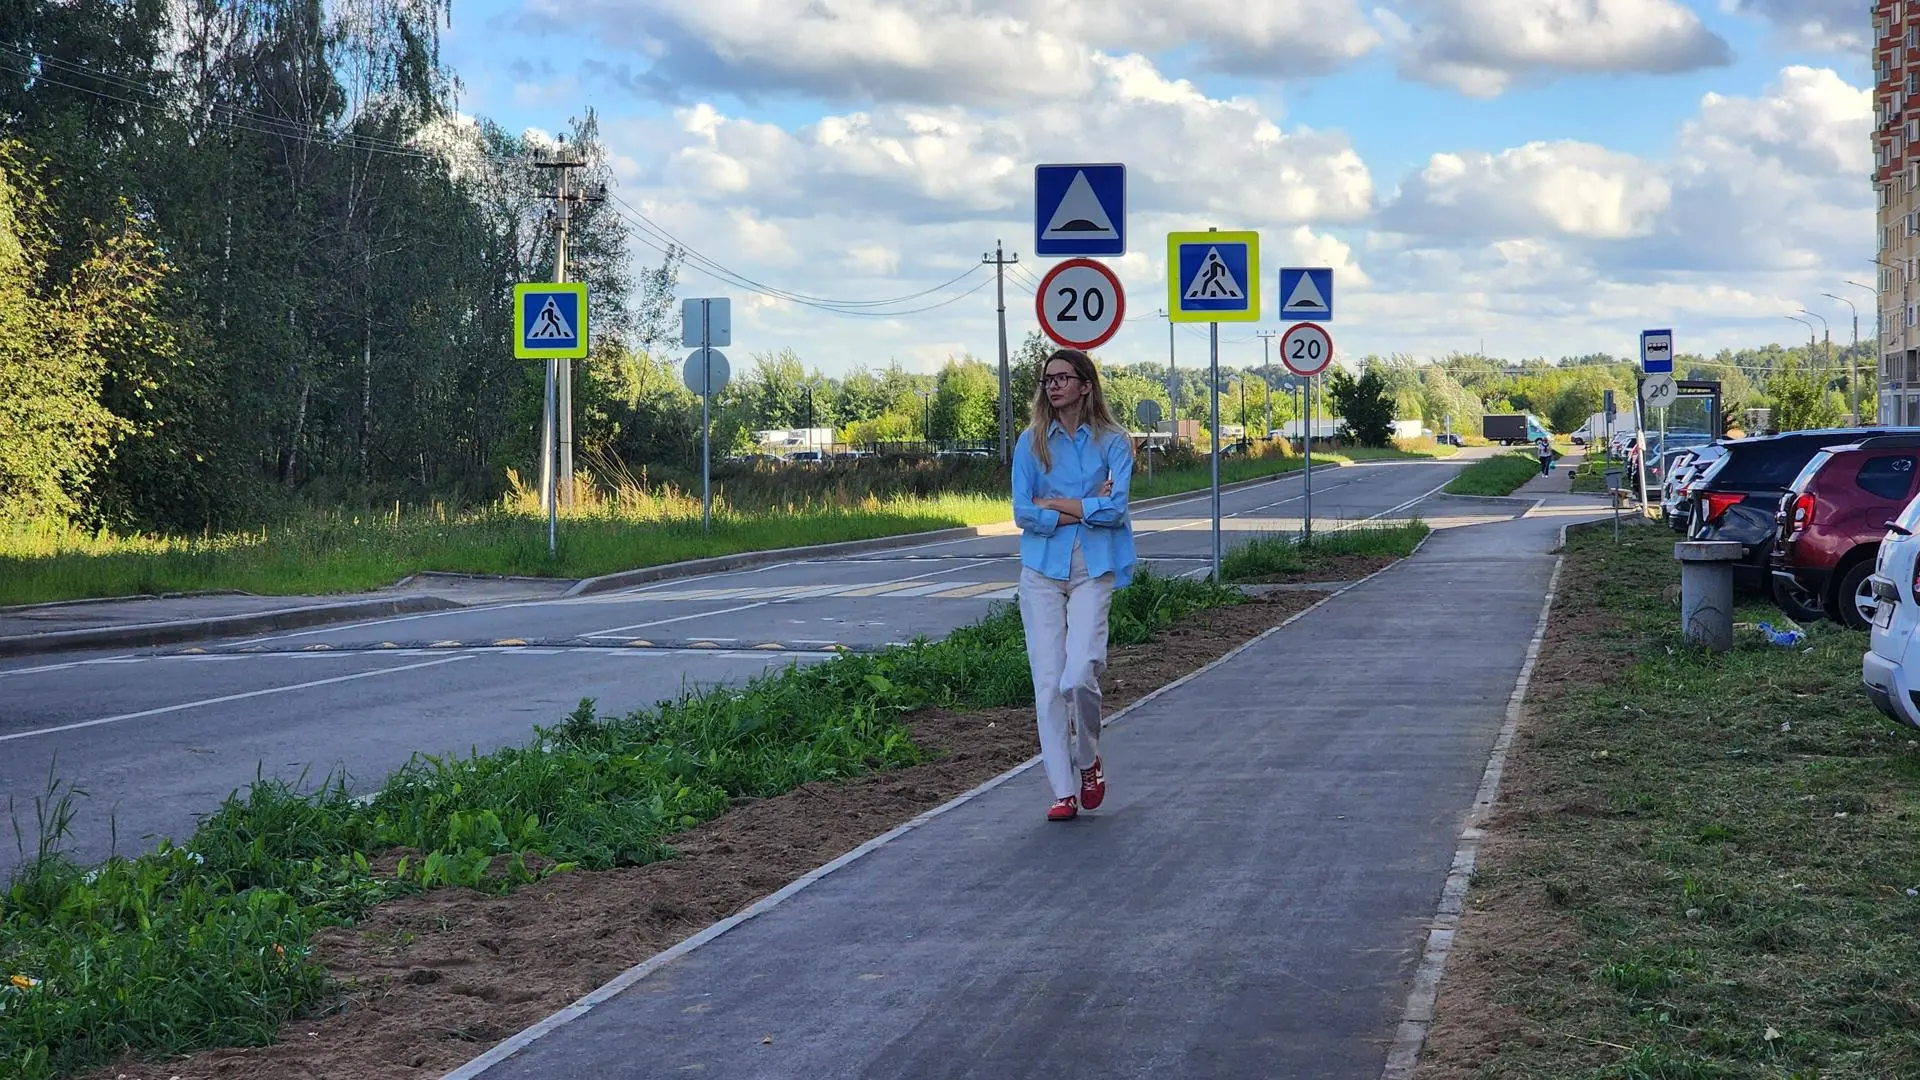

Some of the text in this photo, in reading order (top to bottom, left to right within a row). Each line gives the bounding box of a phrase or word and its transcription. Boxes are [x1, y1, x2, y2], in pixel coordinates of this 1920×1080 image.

[1057, 287, 1104, 322] 20
[1291, 339, 1322, 360] 20
[1650, 384, 1669, 398] 20
